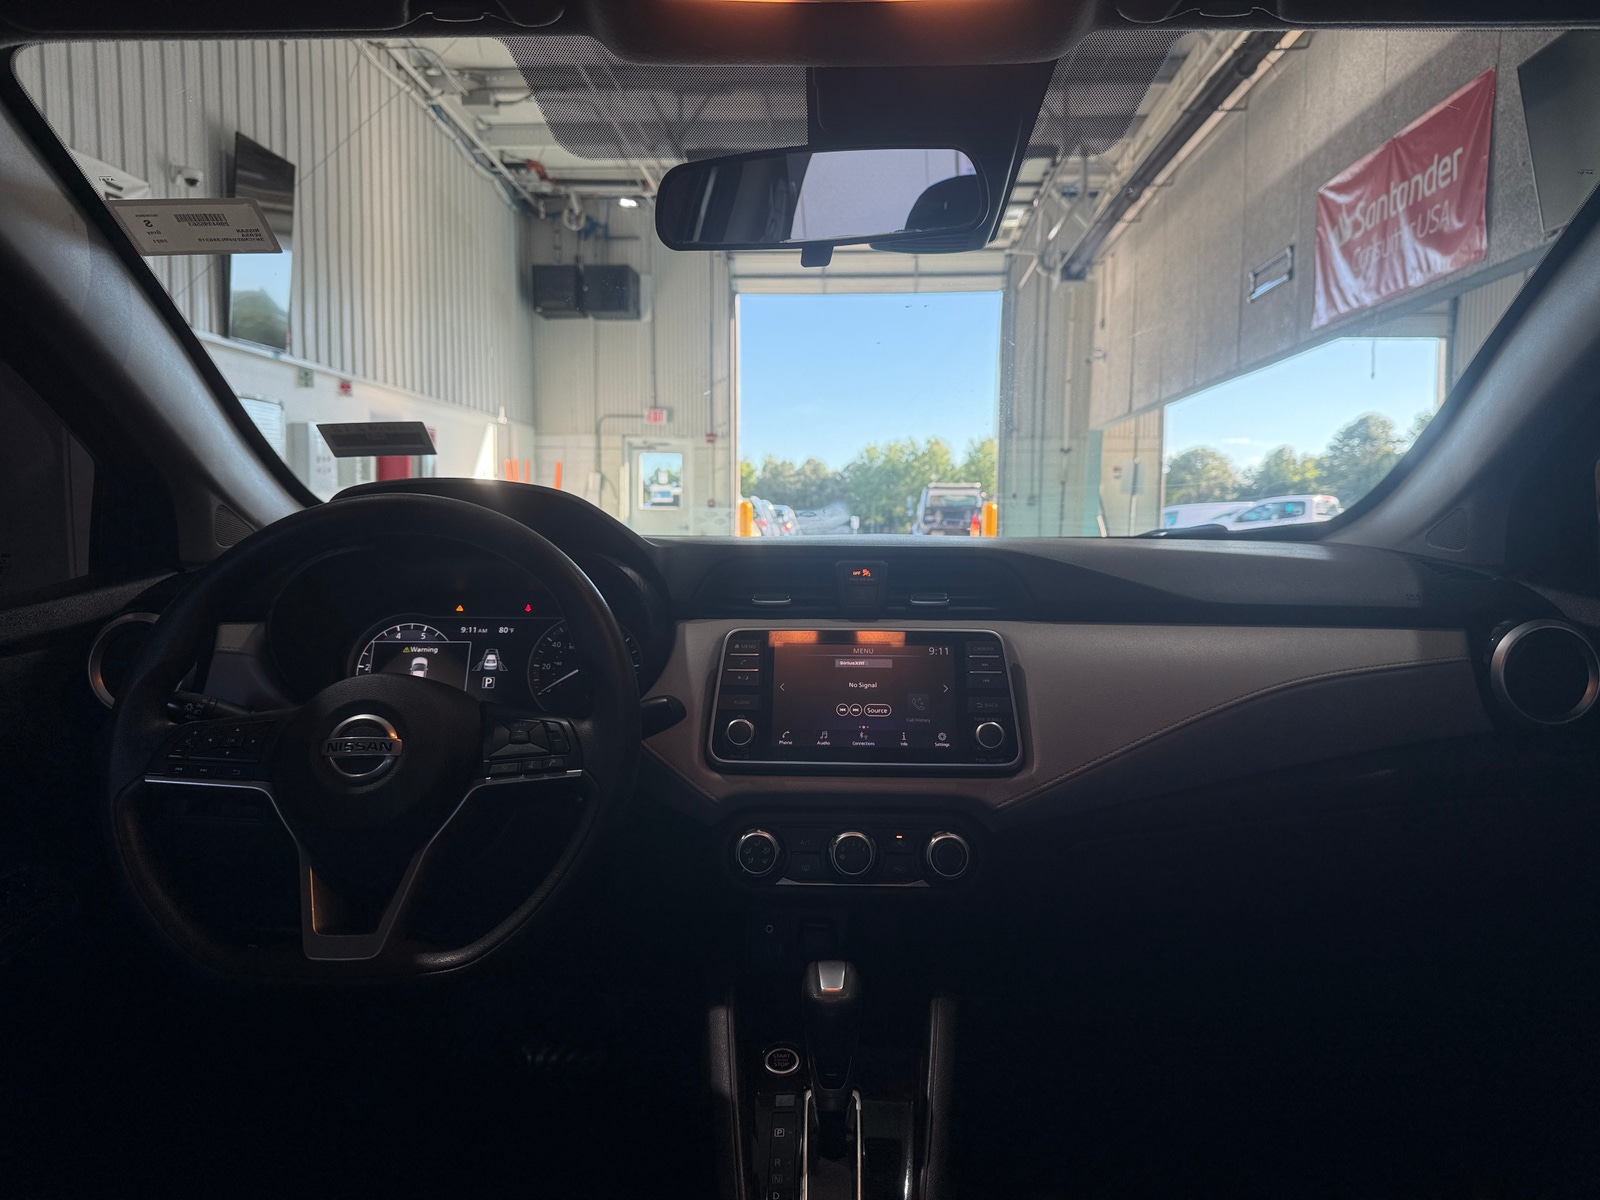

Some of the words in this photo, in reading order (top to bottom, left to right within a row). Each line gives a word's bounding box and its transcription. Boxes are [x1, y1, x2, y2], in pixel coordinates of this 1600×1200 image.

[1352, 147, 1463, 240] Santander
[1351, 222, 1417, 271] Consumr
[1417, 199, 1450, 238] USA
[928, 646, 949, 655] 9:11
[485, 678, 492, 687] P
[327, 741, 393, 754] NISSAN
[772, 1191, 780, 1200] D
